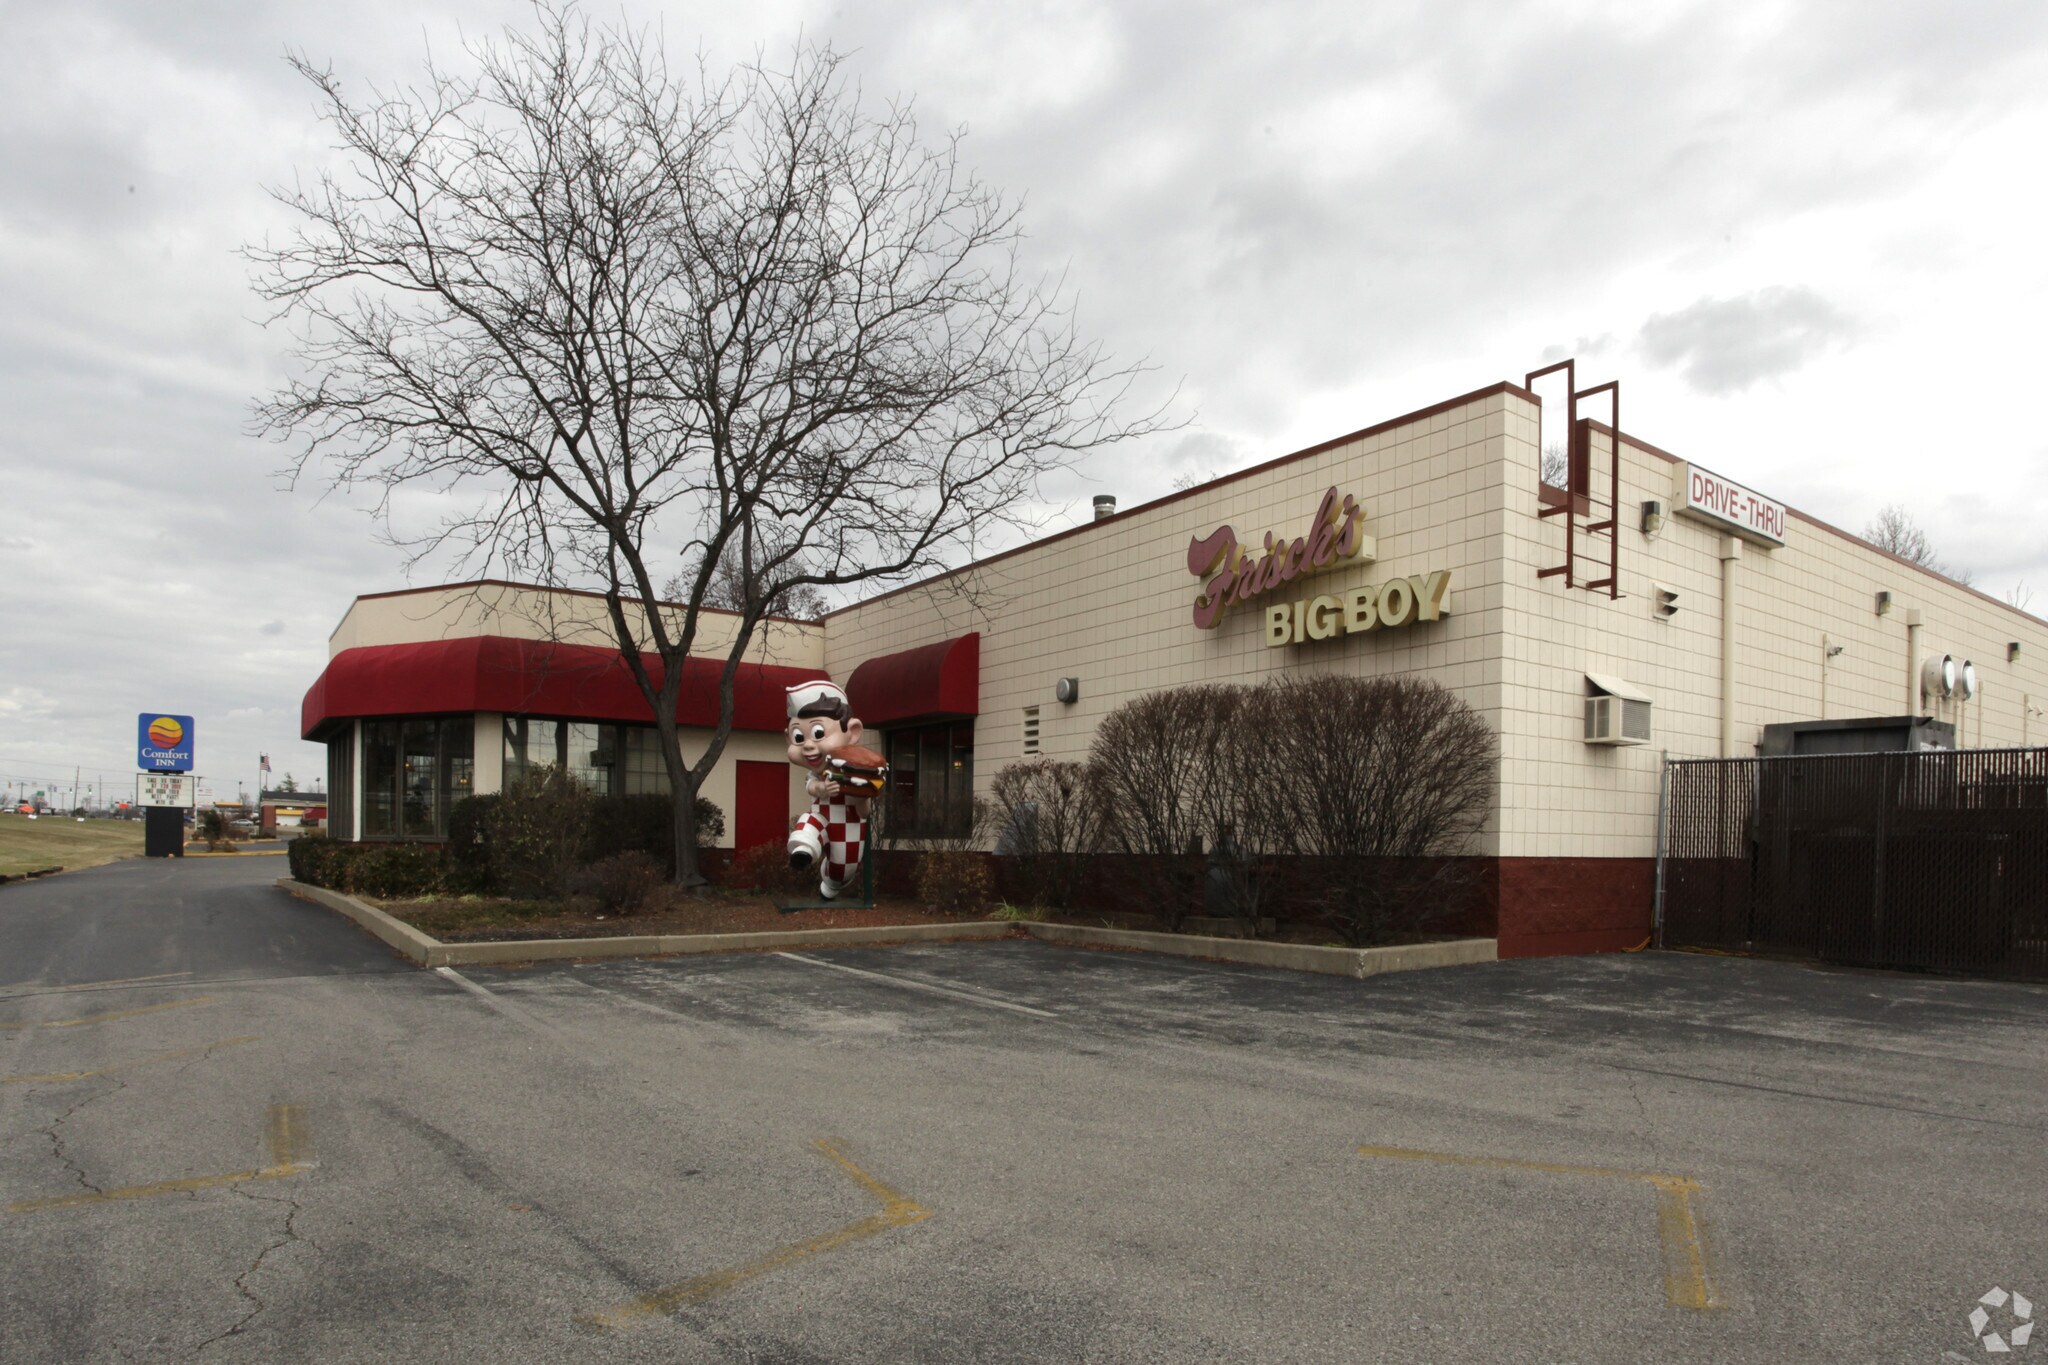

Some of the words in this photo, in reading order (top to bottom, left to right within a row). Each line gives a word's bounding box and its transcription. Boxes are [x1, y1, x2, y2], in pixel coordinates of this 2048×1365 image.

[1692, 472, 1784, 538] DRIVE-THRU
[1187, 485, 1364, 629] Frisch's
[1266, 594, 1344, 647] BIG
[1347, 570, 1452, 633] BOY
[142, 748, 189, 759] Comfort
